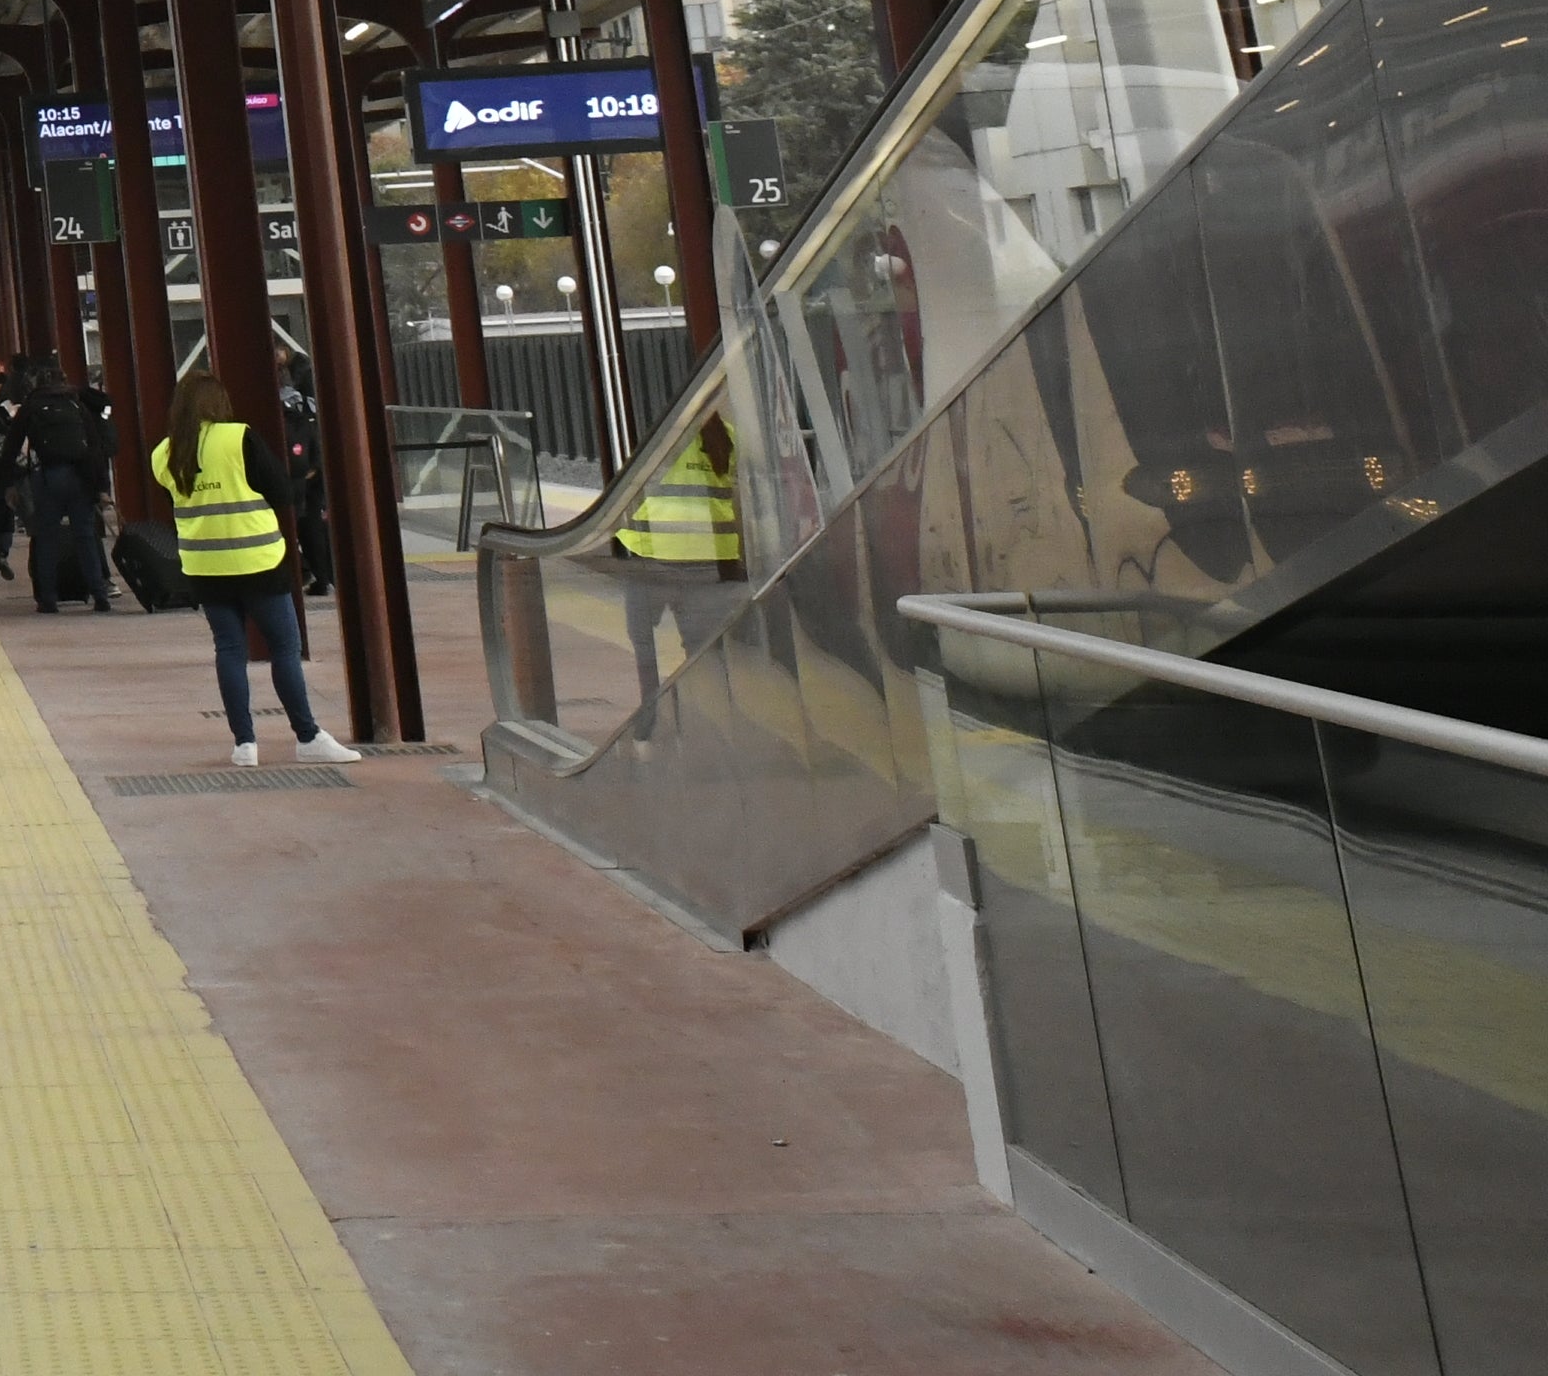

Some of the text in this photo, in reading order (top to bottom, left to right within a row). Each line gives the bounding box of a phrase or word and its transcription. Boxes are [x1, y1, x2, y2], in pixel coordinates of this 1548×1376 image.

[39, 107, 81, 123] 10:15
[477, 100, 544, 124] adif
[586, 94, 659, 119] 10:18
[749, 178, 782, 203] 25
[54, 217, 84, 240] 24
